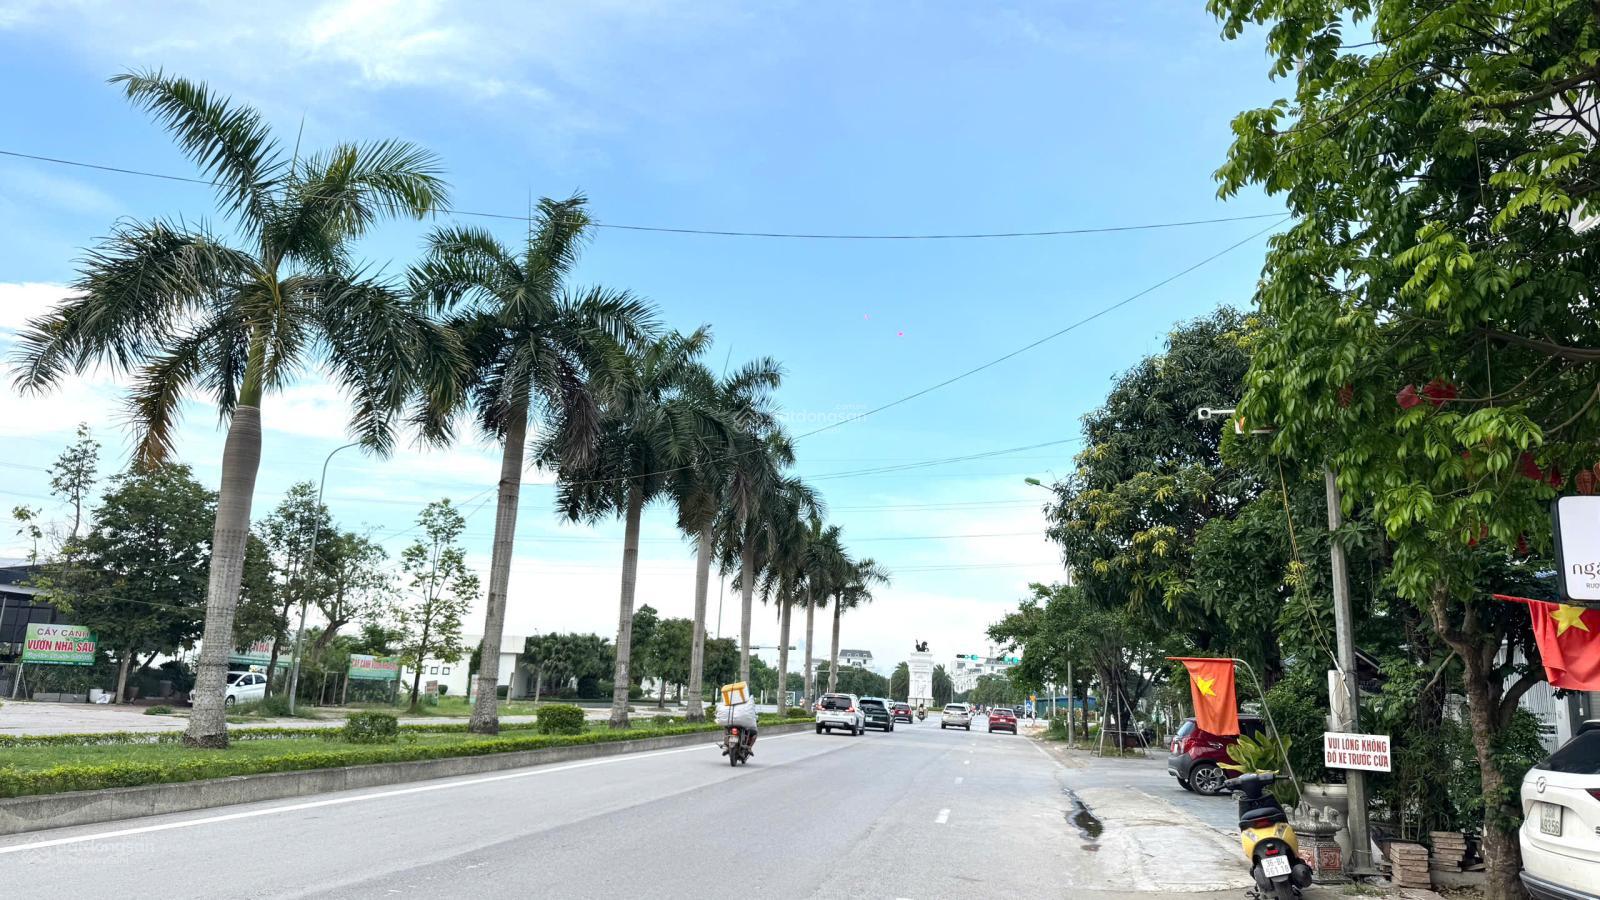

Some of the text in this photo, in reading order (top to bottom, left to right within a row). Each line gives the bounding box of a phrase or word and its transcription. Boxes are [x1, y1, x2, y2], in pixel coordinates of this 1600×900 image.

[1328, 737, 1340, 749] VUI
[1361, 738, 1387, 753] KHÔNG
[1339, 752, 1347, 764] XE
[1348, 752, 1372, 766] TRƯỚC
[1373, 753, 1389, 768] CỬA
